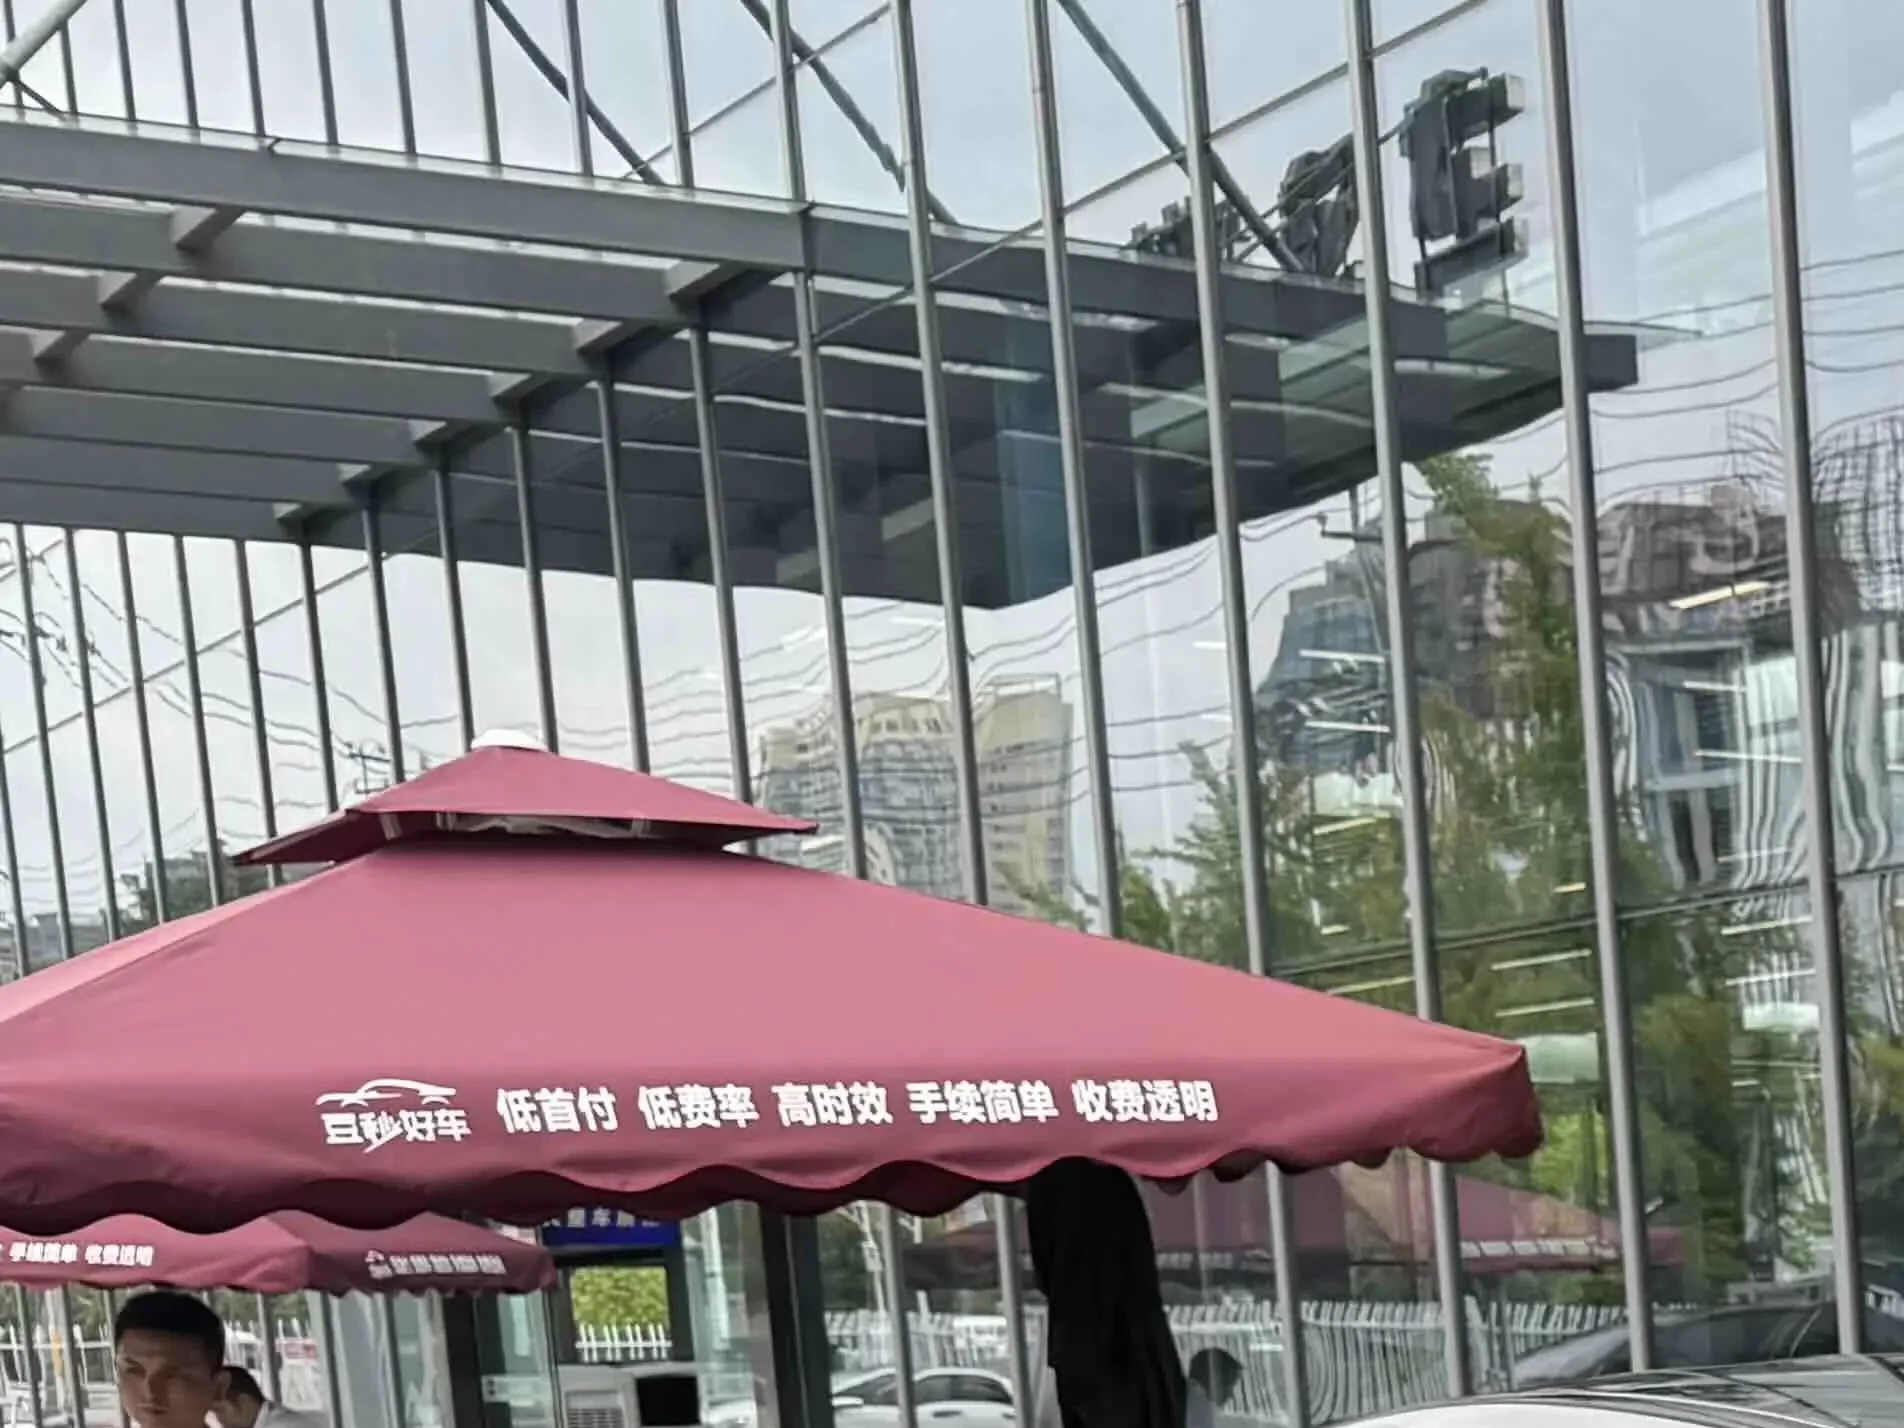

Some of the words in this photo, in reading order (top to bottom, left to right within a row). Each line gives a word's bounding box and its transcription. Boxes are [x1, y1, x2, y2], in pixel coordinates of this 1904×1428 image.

[497, 1086, 618, 1134] 低首付
[638, 1083, 760, 1131] 低费率
[771, 1081, 893, 1128] 高时效
[906, 1080, 1060, 1125] 手续简单
[1070, 1078, 1219, 1123] 收费透明
